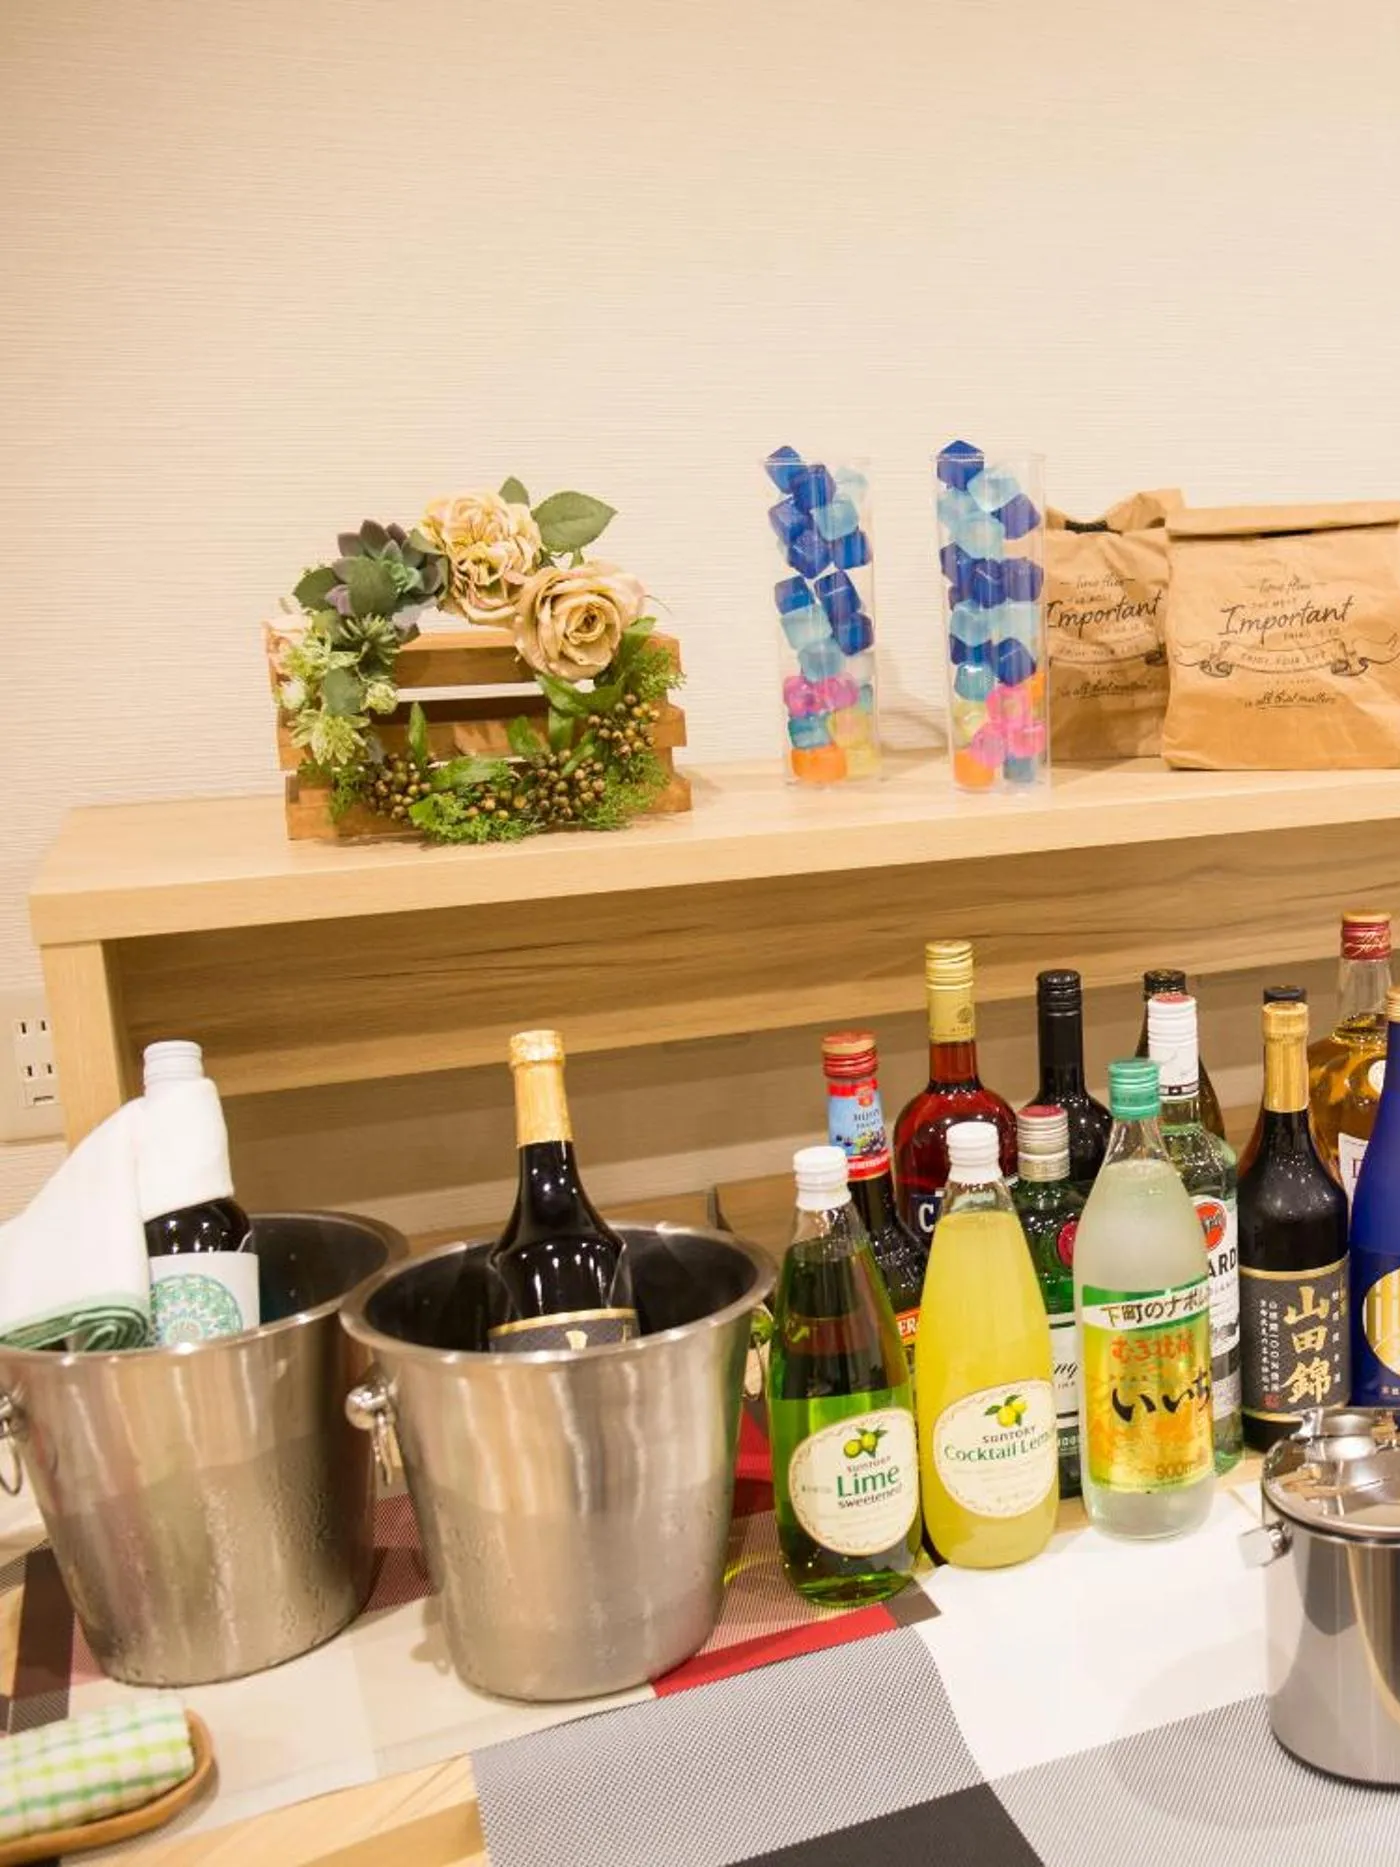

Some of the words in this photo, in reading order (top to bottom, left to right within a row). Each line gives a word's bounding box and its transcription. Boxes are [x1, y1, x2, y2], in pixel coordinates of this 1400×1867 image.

[1047, 589, 1163, 640] Important
[1217, 594, 1354, 645] Important
[1281, 1285, 1332, 1404] 山田錦
[944, 1440, 1017, 1461] Cocktail
[837, 1465, 900, 1497] Lime
[838, 1483, 904, 1509] sweetened
